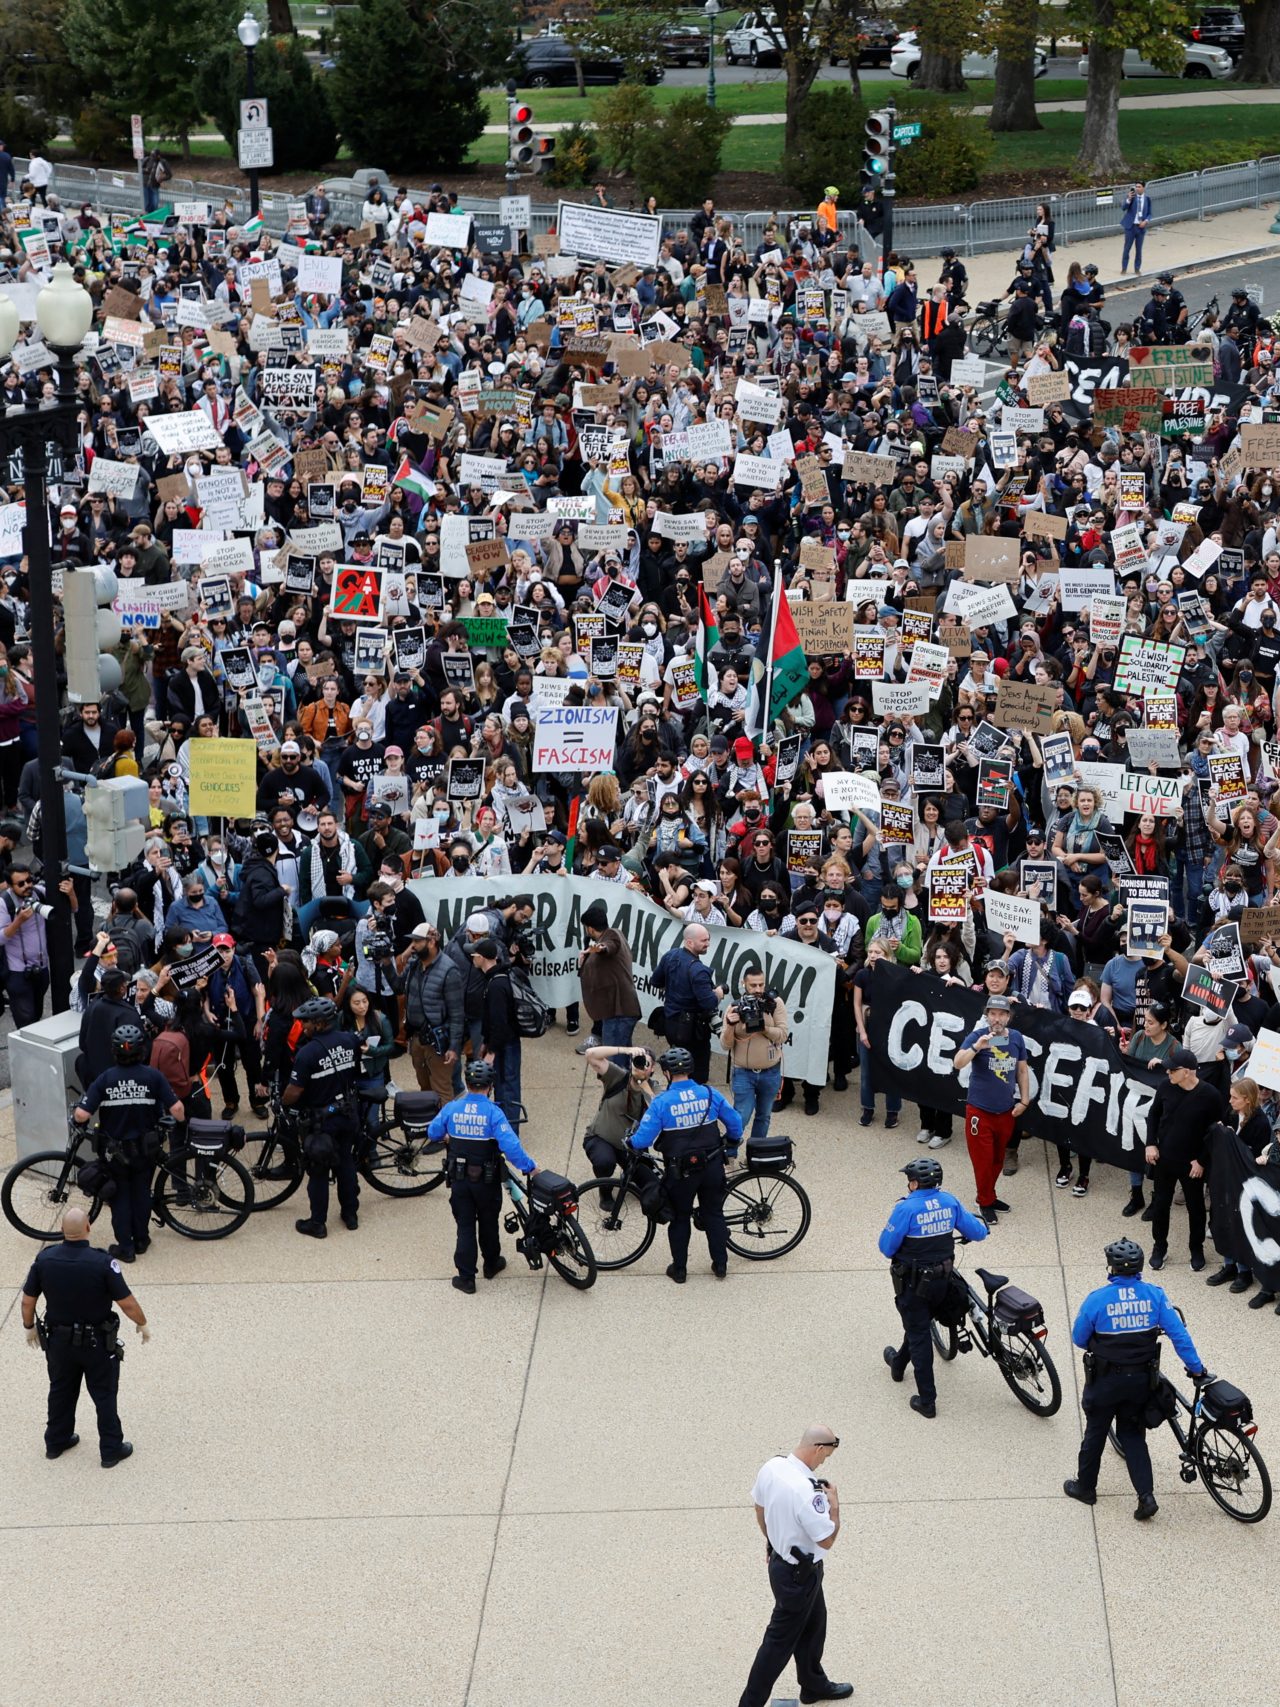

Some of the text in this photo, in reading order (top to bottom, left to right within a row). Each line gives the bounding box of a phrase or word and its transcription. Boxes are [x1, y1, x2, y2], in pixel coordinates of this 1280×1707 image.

[893, 126, 914, 138] CAPITOL
[1152, 347, 1190, 366] FREE
[265, 372, 315, 384] JEWS SAY
[1131, 366, 1214, 387] PALESTINE
[264, 383, 314, 396] CEASEFIRE
[1173, 401, 1199, 416] FREE
[1164, 416, 1205, 431] PALESTINE
[581, 433, 614, 444] CEASE
[1122, 479, 1145, 487] CEASE
[1122, 494, 1144, 502] GAZA
[466, 543, 505, 555] CEASEFIRE
[473, 551, 502, 561] NOW
[968, 599, 1009, 619] CEASEFIRE
[122, 613, 159, 628] NOW
[941, 626, 966, 638] VIVA
[804, 638, 849, 652] MISHPACHA
[857, 642, 884, 652] CEASE
[860, 651, 880, 660] FIRE
[1134, 649, 1169, 663] JEWISH
[858, 660, 883, 670] GAZA
[1129, 659, 1172, 673] SOLIDARITY
[859, 669, 882, 677] NOW!
[1126, 671, 1168, 686] PALESTINE
[879, 696, 923, 705] GENOCIDE
[539, 707, 616, 725] ZIONISM
[538, 747, 614, 766] FASCISM
[1211, 763, 1241, 775] CEASE
[1219, 770, 1240, 783] FIRE
[1121, 774, 1180, 798] LET GAZA
[1129, 795, 1171, 815] LIVE
[932, 876, 966, 886] CEASE
[935, 886, 962, 895] FIRE
[931, 898, 966, 908] GAZA
[935, 907, 961, 916] NOW!
[990, 909, 1032, 925] CEASEFIRE
[323, 1055, 353, 1071] POLICE
[106, 1086, 150, 1094] CAPITOL
[109, 1092, 145, 1100] POLICE
[680, 1091, 696, 1101] U.S.
[464, 1104, 477, 1113] U.S.
[453, 1114, 487, 1125] CAPITOL
[676, 1112, 708, 1127] POLICE
[455, 1124, 484, 1136] POLICE
[925, 1200, 940, 1210] U.S.
[917, 1209, 952, 1225] CAPITOL
[921, 1220, 951, 1233] POLICE
[1119, 1288, 1137, 1300] U.S.
[1107, 1301, 1152, 1316] CAPITOL
[1112, 1315, 1149, 1329] POLICE
